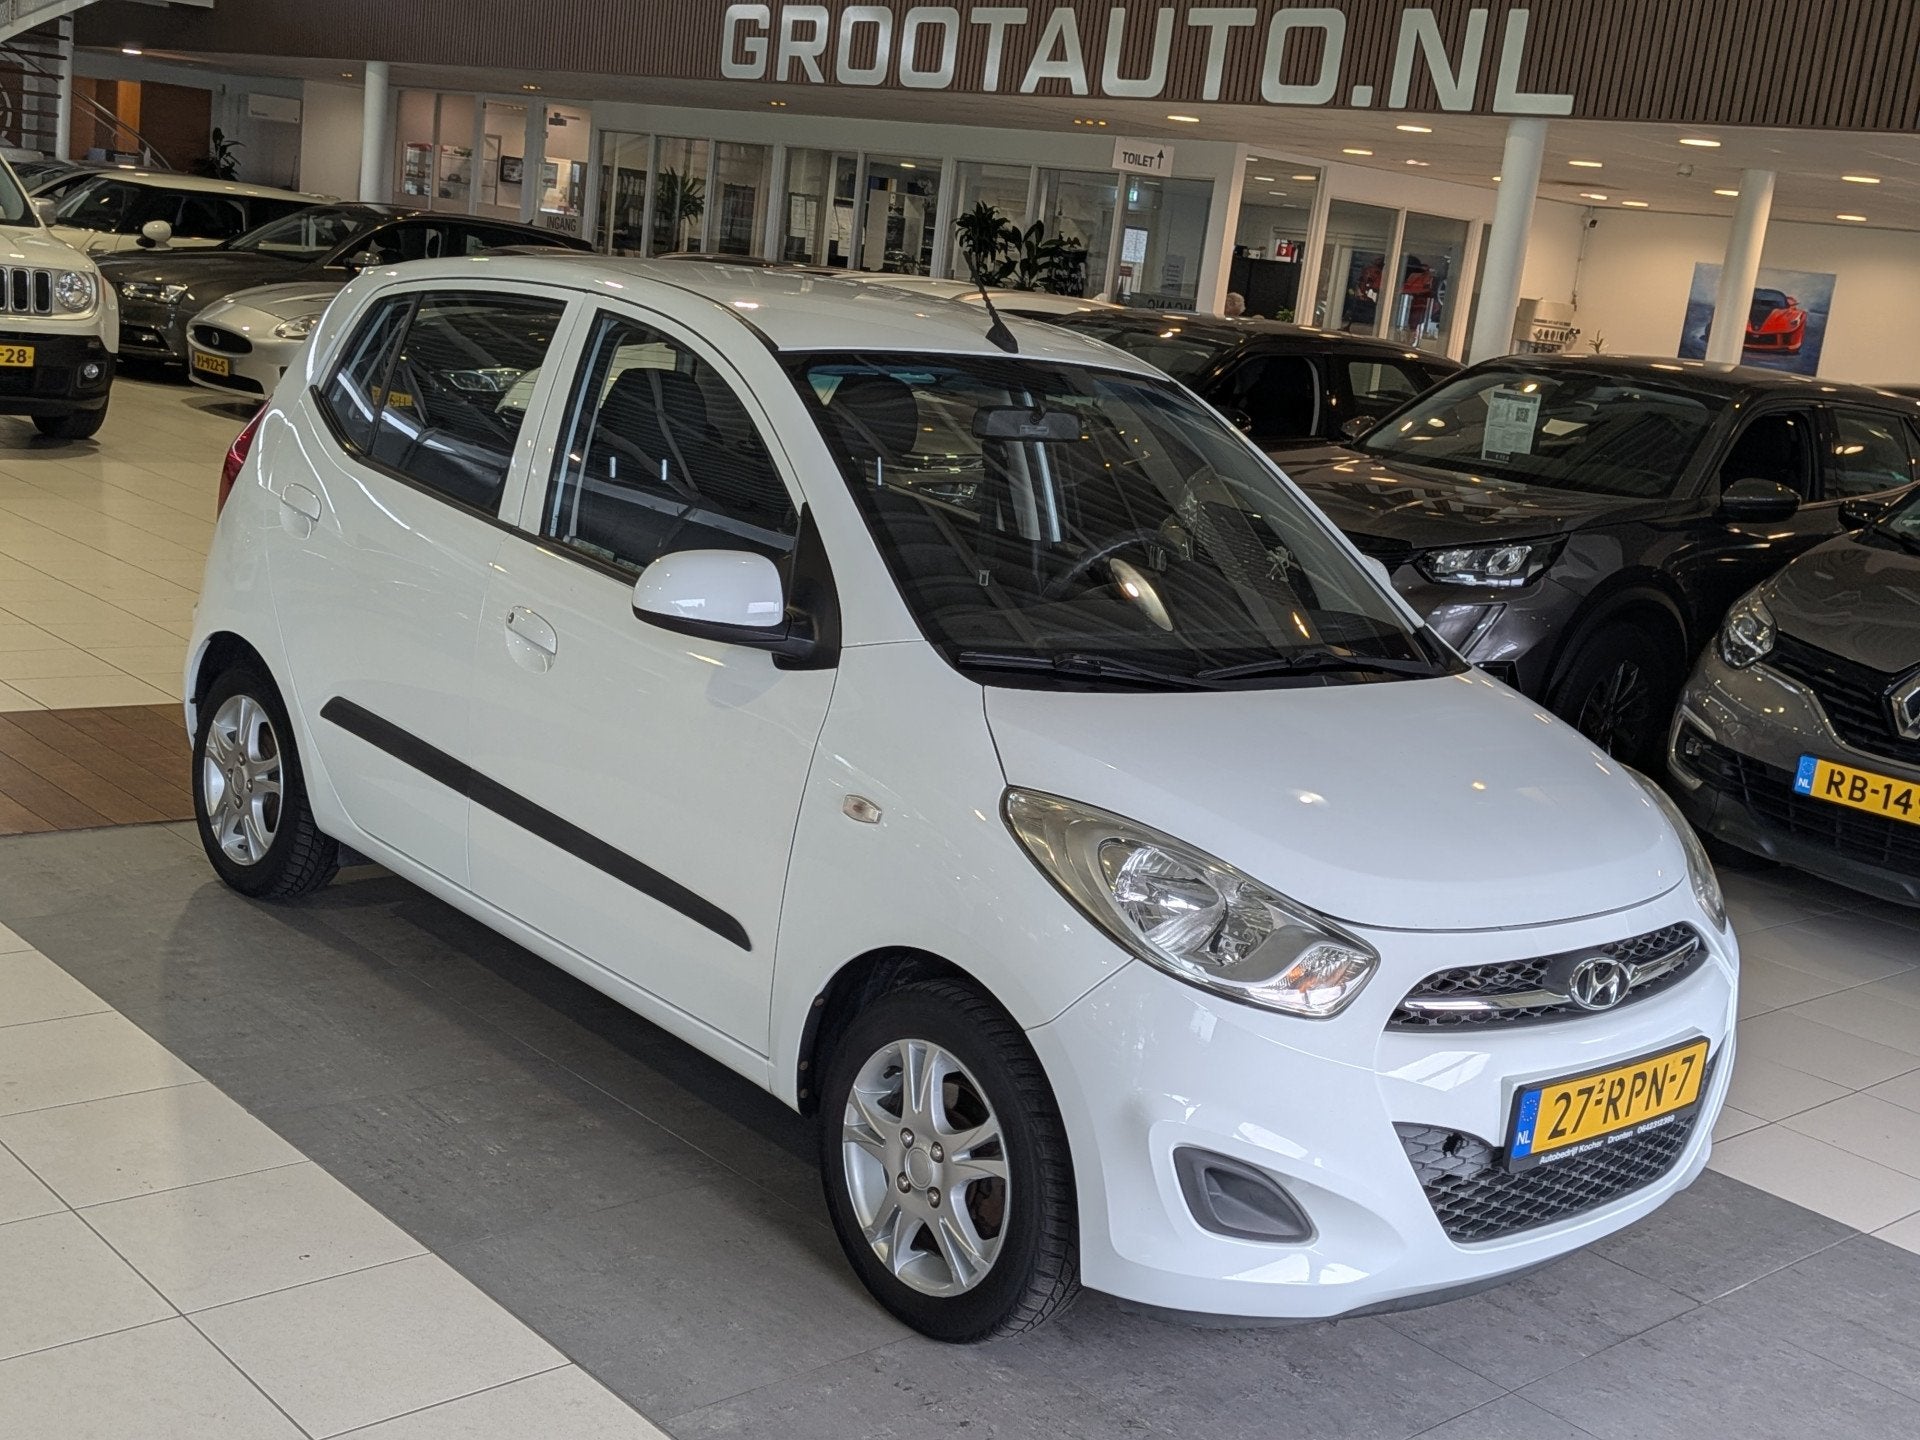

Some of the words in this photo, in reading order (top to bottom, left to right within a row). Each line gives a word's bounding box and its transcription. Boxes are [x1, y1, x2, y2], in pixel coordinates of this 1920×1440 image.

[721, 3, 1574, 116] GROOTAUTO.NL
[1122, 151, 1155, 168] TOILET
[546, 216, 577, 231] INGANG
[1797, 777, 1811, 789] NL
[1825, 768, 1920, 820] RB-14
[1516, 1131, 1531, 1146] NL
[1539, 1146, 1579, 1165] Autobedrijf
[1578, 1140, 1605, 1154] Kocher
